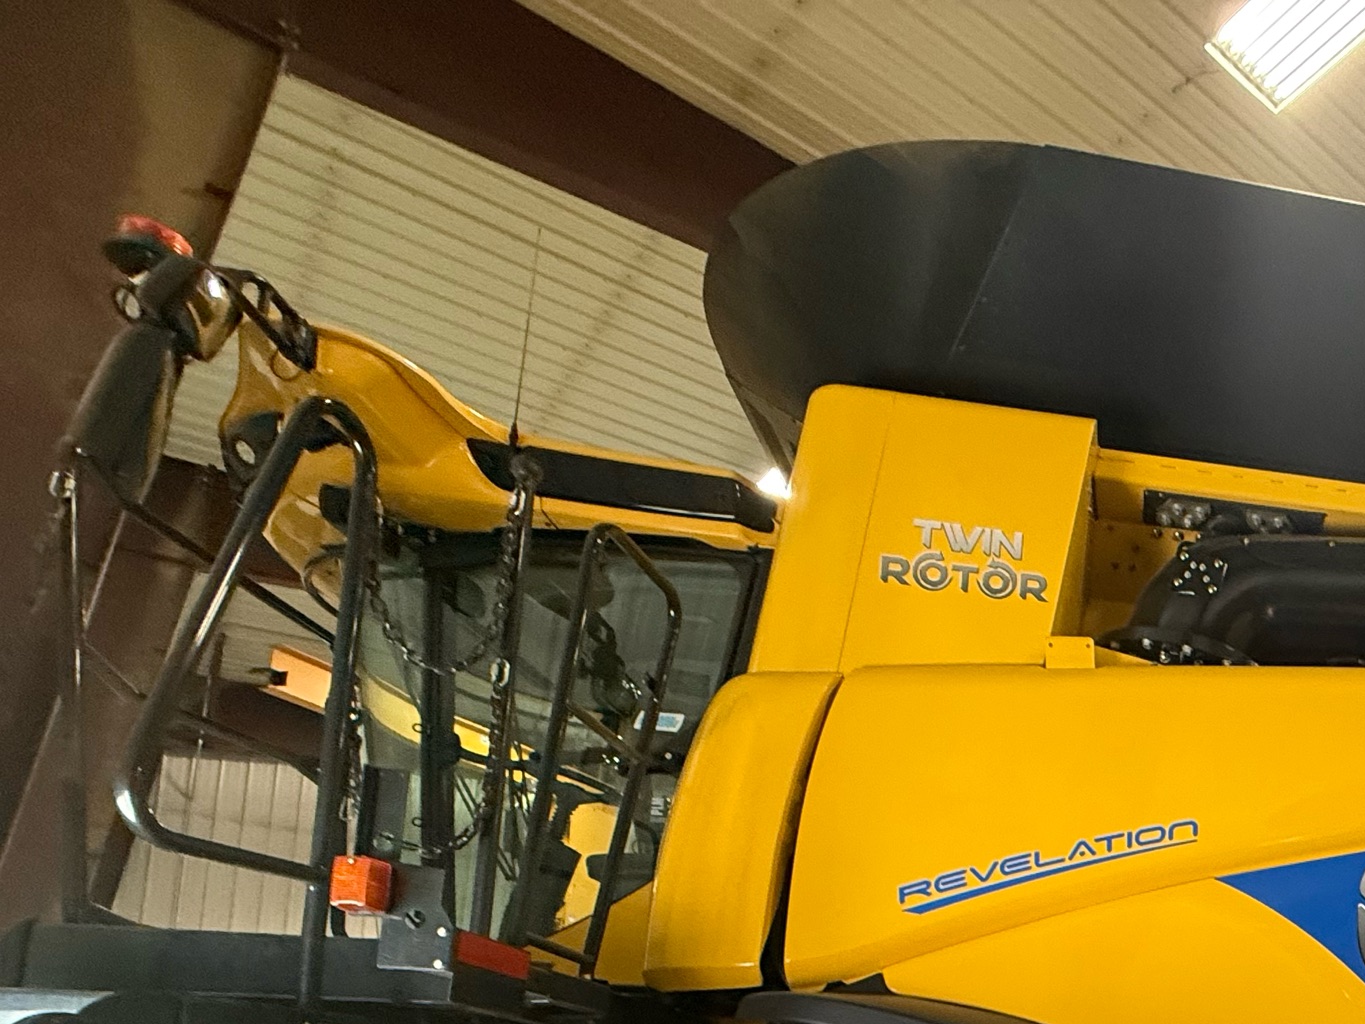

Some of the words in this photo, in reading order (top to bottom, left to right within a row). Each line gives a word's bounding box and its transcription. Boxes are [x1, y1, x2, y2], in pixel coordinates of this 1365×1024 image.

[913, 518, 1024, 561] TWIN
[880, 550, 1048, 603] ROTOR
[898, 820, 1198, 904] REVELATION
